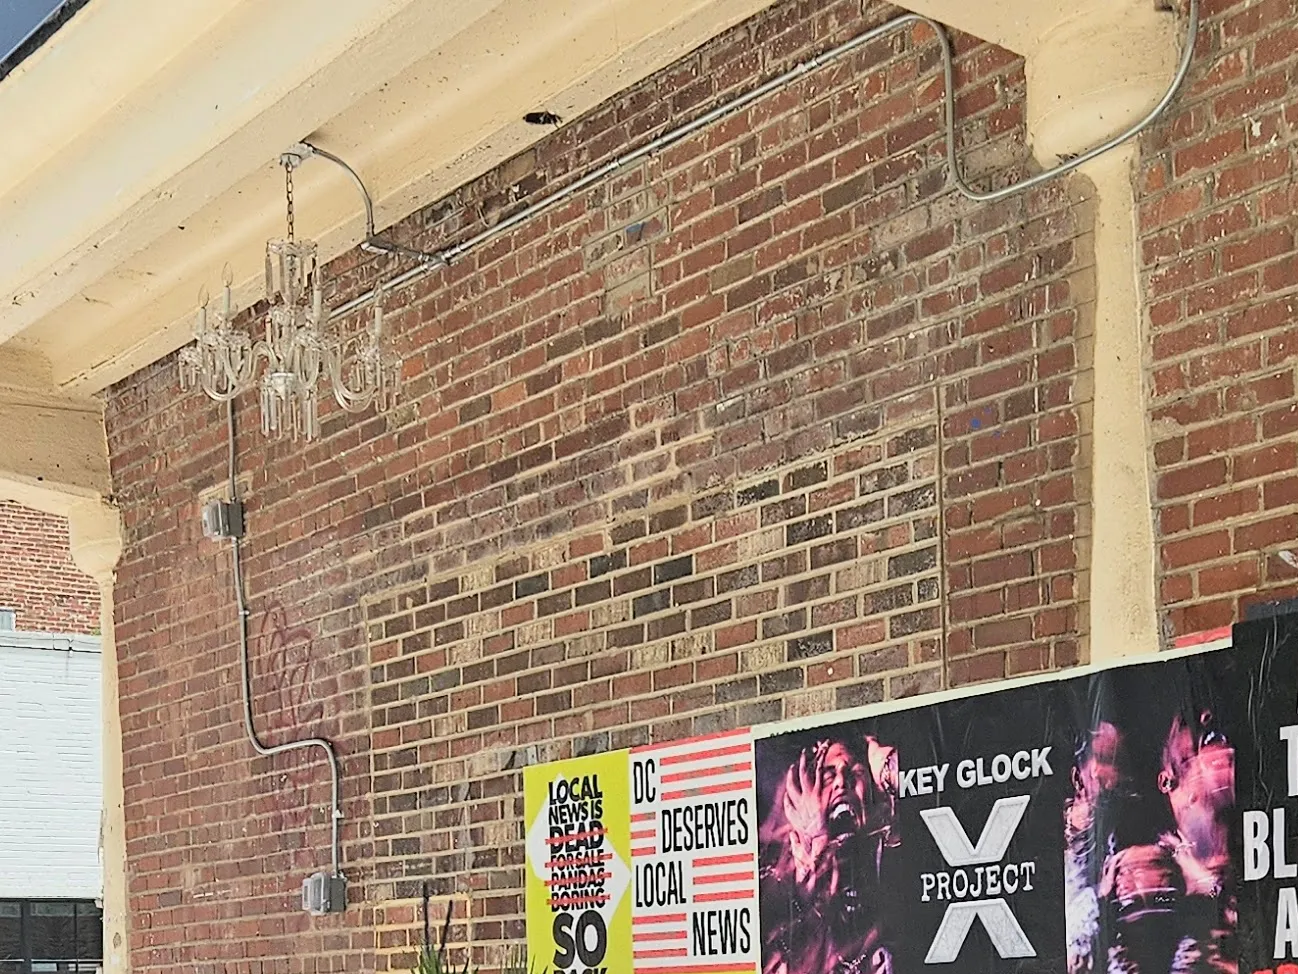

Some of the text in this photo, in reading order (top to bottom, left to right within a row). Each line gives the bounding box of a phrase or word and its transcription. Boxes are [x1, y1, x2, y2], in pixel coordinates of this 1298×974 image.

[548, 774, 603, 805] LOCAL
[633, 758, 656, 804] DC
[900, 746, 1053, 798] KEY GLOCK
[548, 799, 603, 825] NEWS IS
[662, 798, 748, 853] DESERVES
[549, 820, 604, 854] DEAD
[551, 849, 605, 872] FOR SALE
[551, 868, 605, 891] PANDAS
[551, 888, 606, 912] BORING
[635, 861, 686, 908] LOCAL
[920, 862, 1036, 902] PROJECT
[552, 909, 607, 969] SO
[692, 907, 750, 956] NEWS
